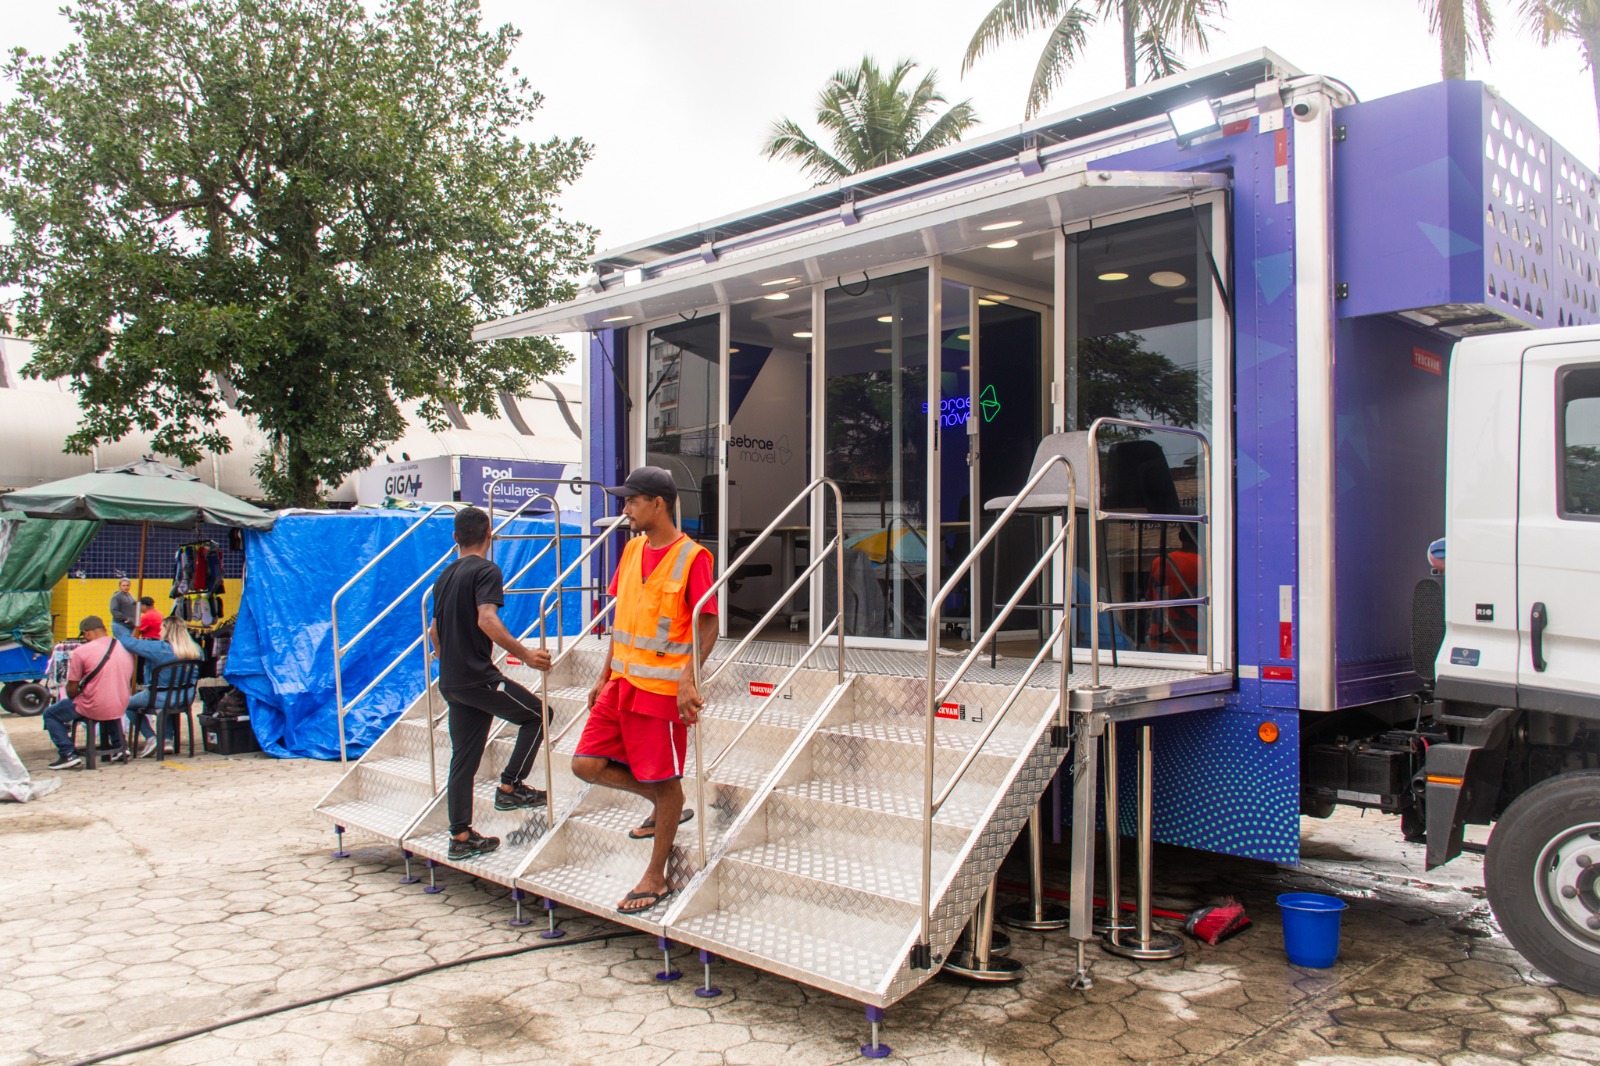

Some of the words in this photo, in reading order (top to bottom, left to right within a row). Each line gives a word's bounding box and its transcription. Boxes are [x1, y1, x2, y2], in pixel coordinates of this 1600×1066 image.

[730, 434, 773, 450] sebrae
[482, 466, 512, 479] Pool
[482, 482, 540, 496] Celulares
[938, 706, 958, 716] CKVAN
